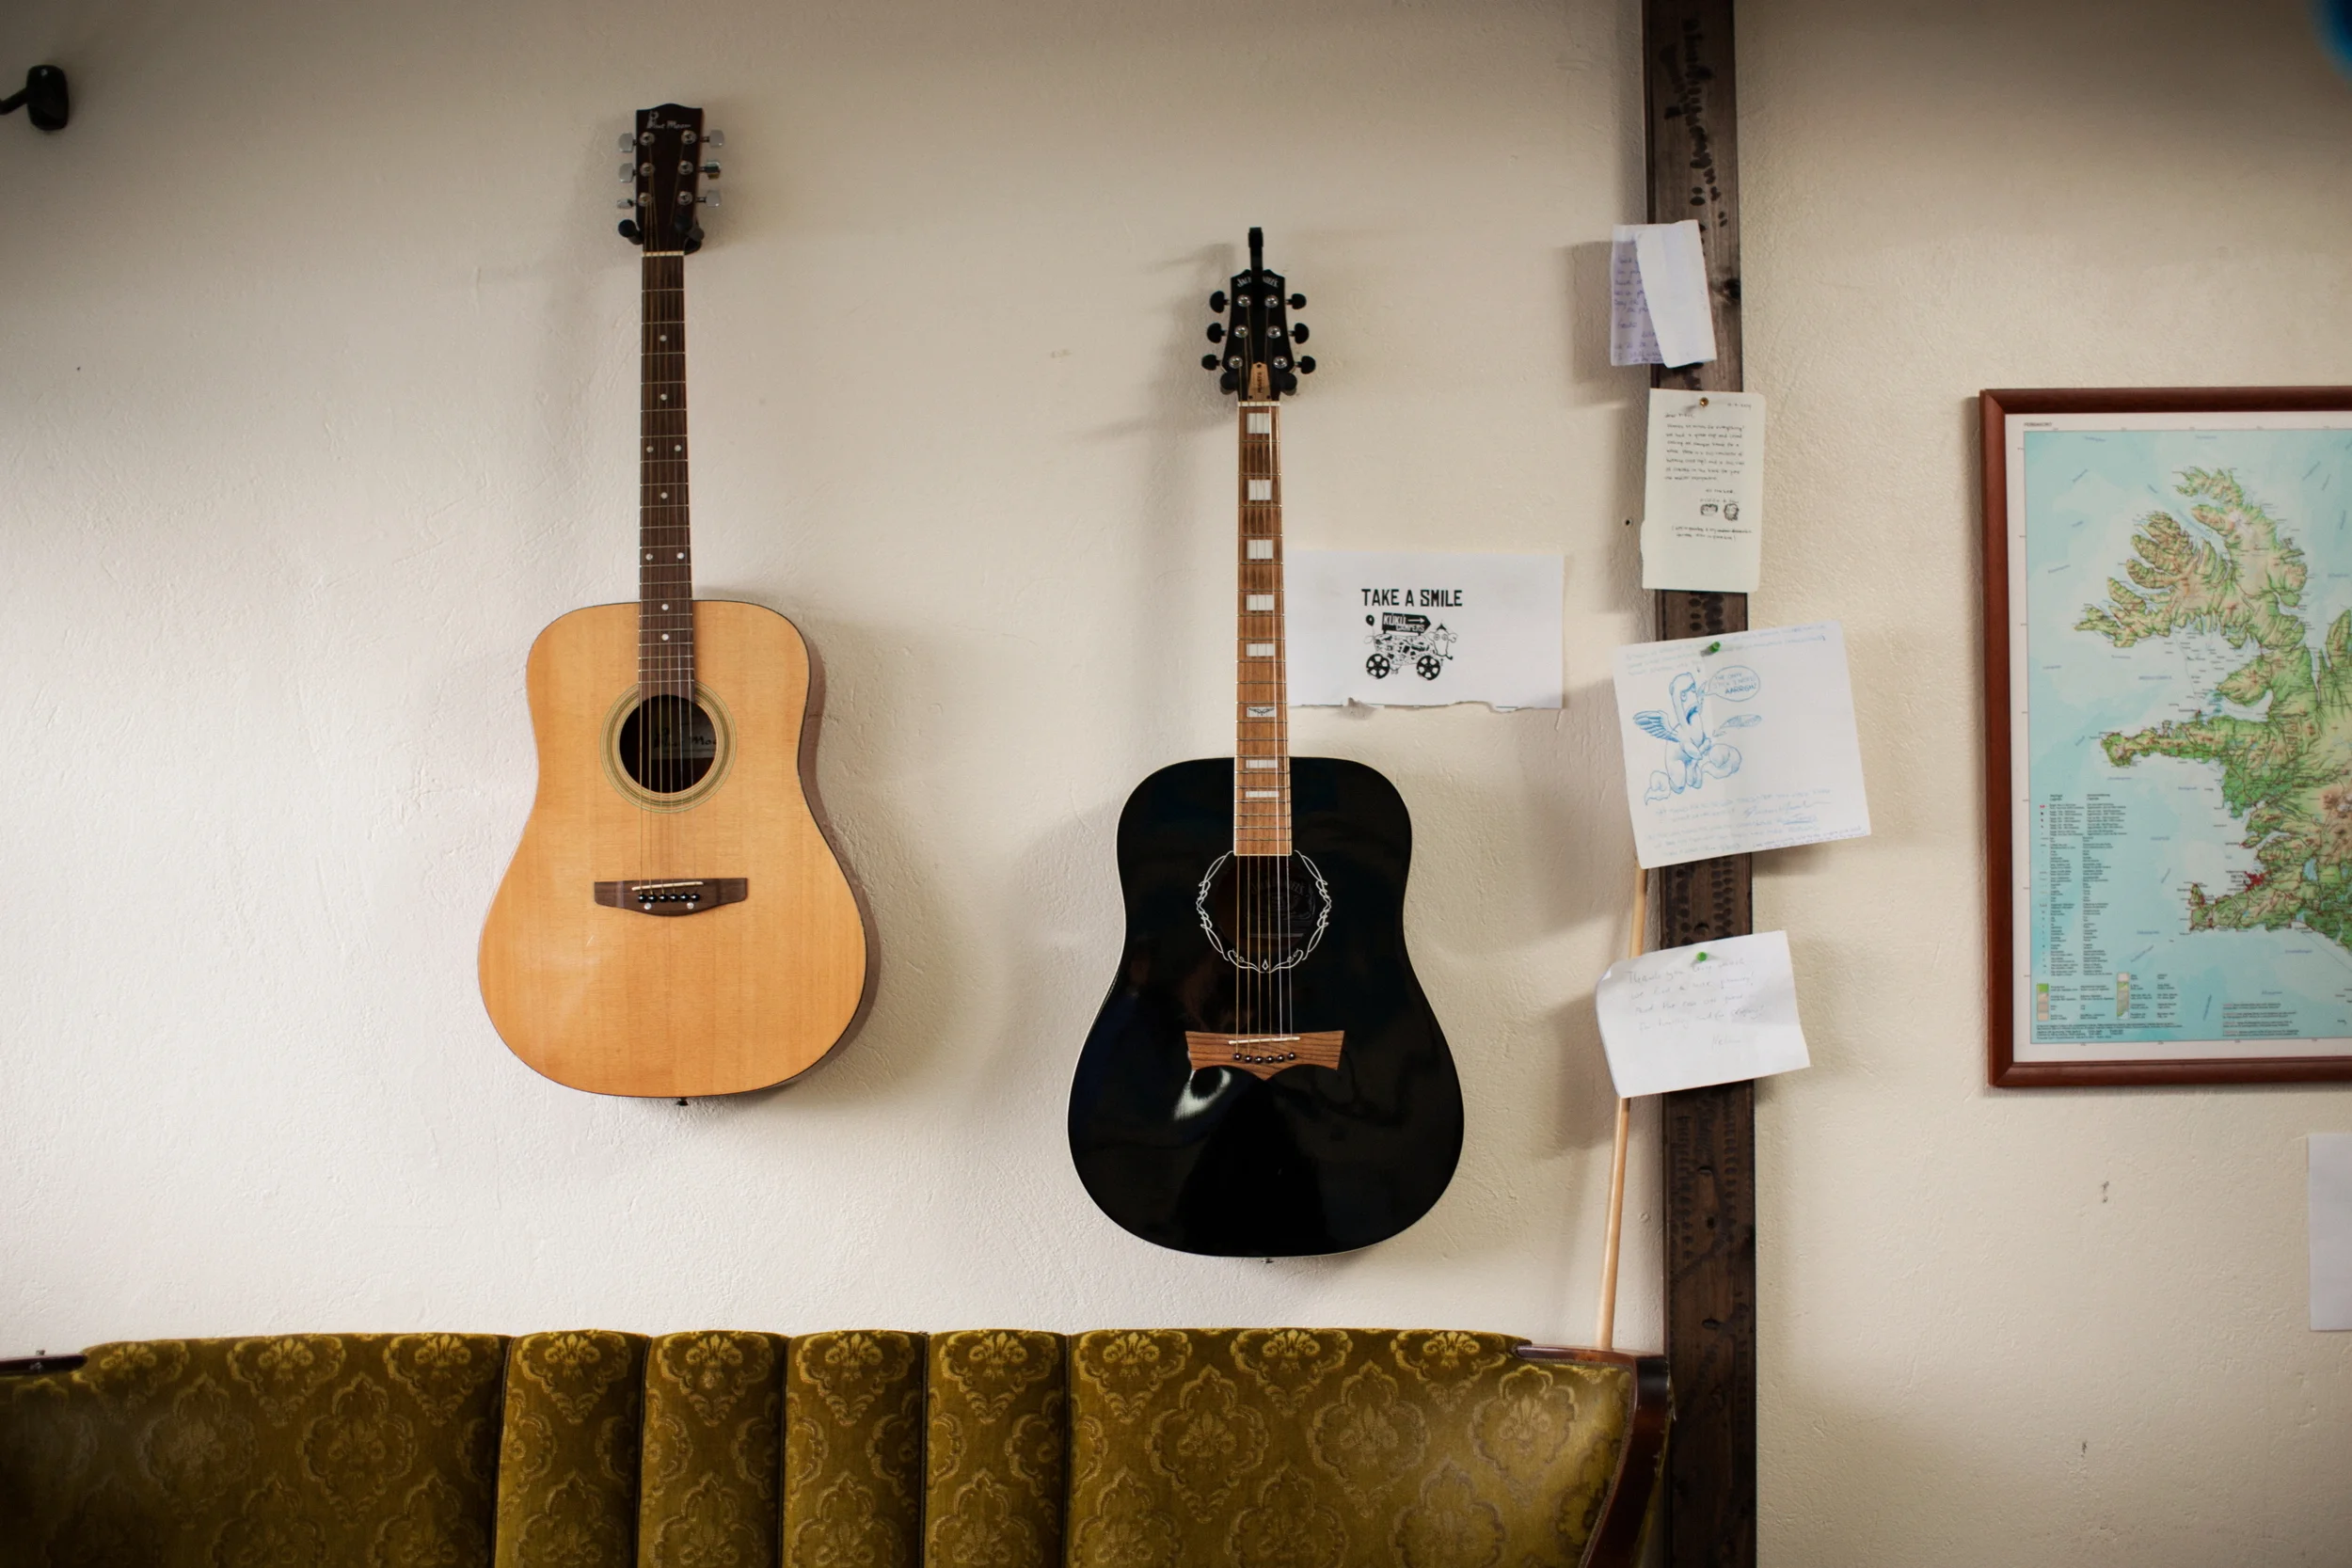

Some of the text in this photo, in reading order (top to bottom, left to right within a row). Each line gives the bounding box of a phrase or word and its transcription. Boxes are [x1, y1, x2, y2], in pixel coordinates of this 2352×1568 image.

[1361, 589, 1463, 608] TAKE A SMILE
